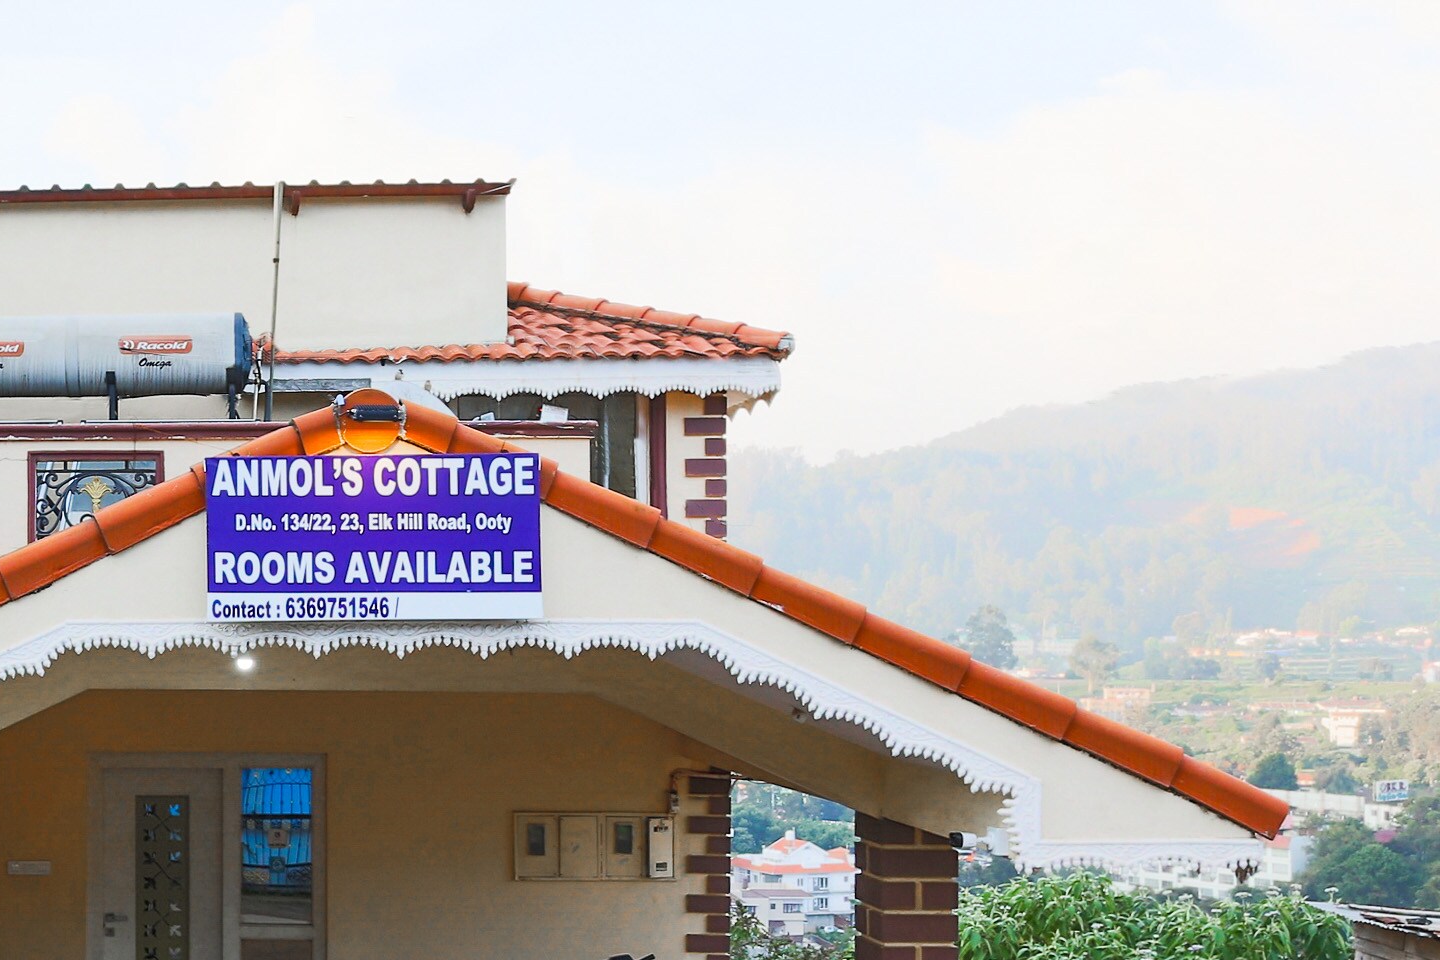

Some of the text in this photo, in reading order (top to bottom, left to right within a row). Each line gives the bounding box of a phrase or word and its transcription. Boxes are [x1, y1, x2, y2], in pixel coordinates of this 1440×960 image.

[136, 340, 188, 351] Racold
[138, 357, 172, 368] Omega
[211, 457, 536, 497] ANMOL'S COTTAGE
[235, 512, 512, 534] D.No. 134/22, 23, Elk Hill Road, Ooty
[213, 550, 535, 585] ROOMS AVAILABLE
[211, 599, 272, 619] Contact
[285, 597, 390, 619] 6369751546
